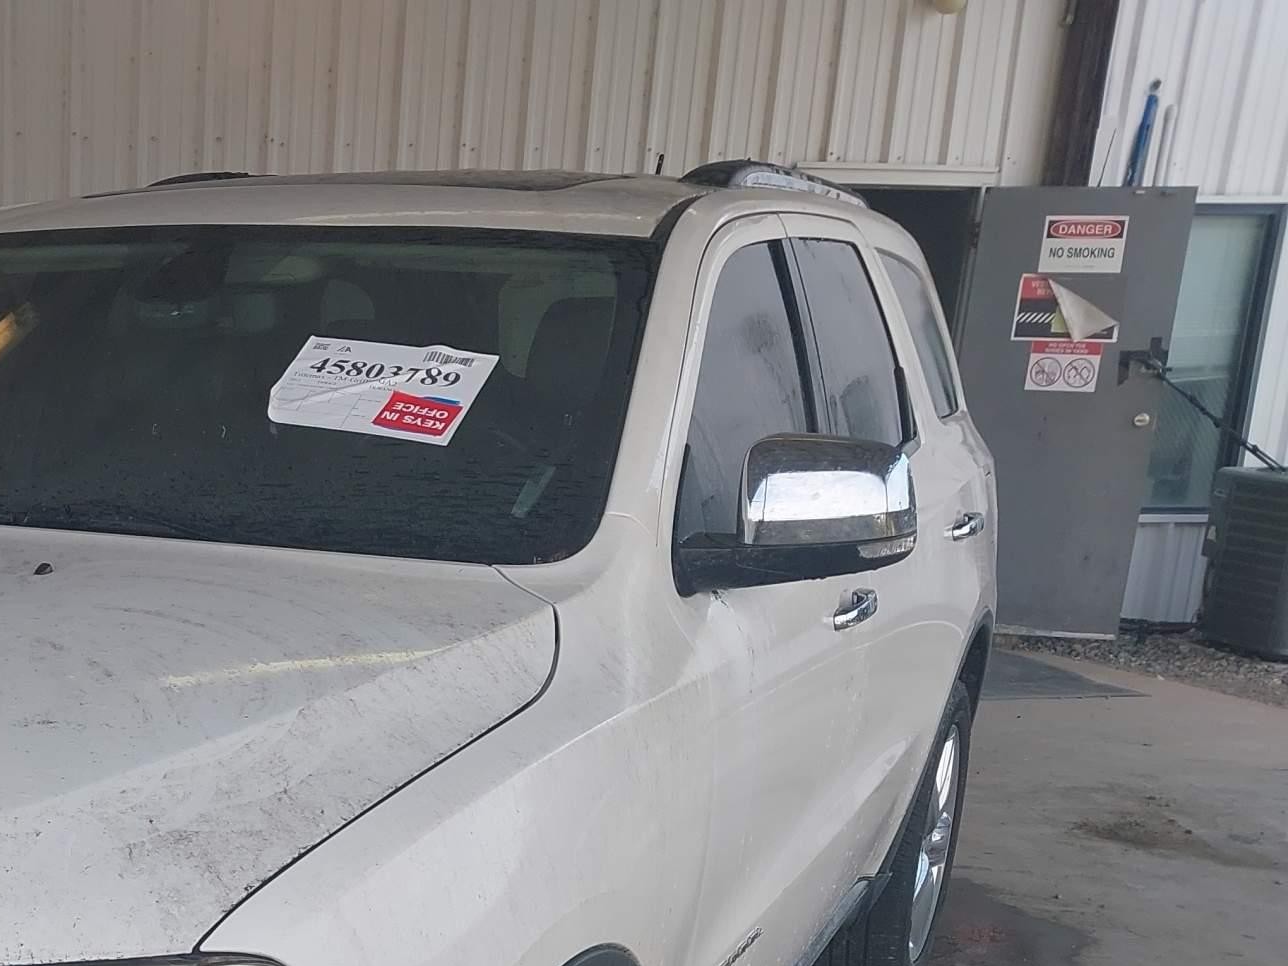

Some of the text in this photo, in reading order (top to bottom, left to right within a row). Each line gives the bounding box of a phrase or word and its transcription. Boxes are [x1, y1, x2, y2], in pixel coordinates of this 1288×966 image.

[1058, 224, 1113, 235] DANGER
[1048, 247, 1116, 259] NO SMOKING
[310, 357, 461, 388] 45803789
[392, 401, 449, 418] OFFICE
[381, 410, 445, 430] KEYS IN
